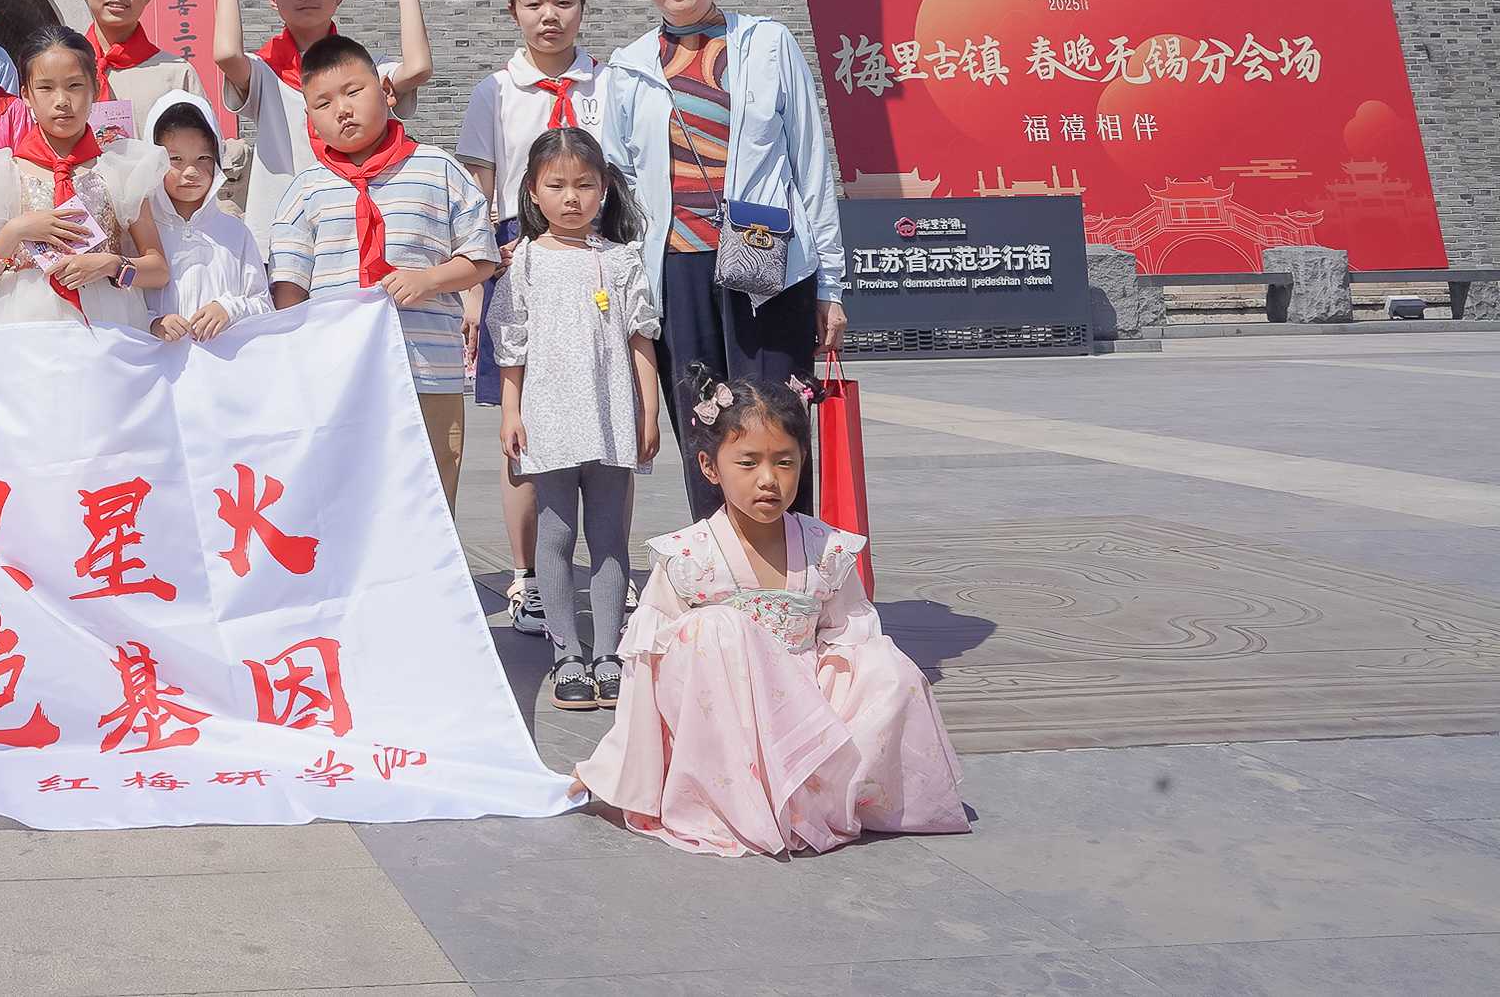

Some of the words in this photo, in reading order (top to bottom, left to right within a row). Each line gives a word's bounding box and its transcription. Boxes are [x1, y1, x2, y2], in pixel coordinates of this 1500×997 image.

[832, 34, 1010, 97] 梅里古镇
[1025, 32, 1323, 85] 春晚无锡分会场
[1022, 113, 1160, 142] 福禧相伴
[852, 244, 1051, 274] 江苏省示范步行街
[857, 279, 899, 289] Province
